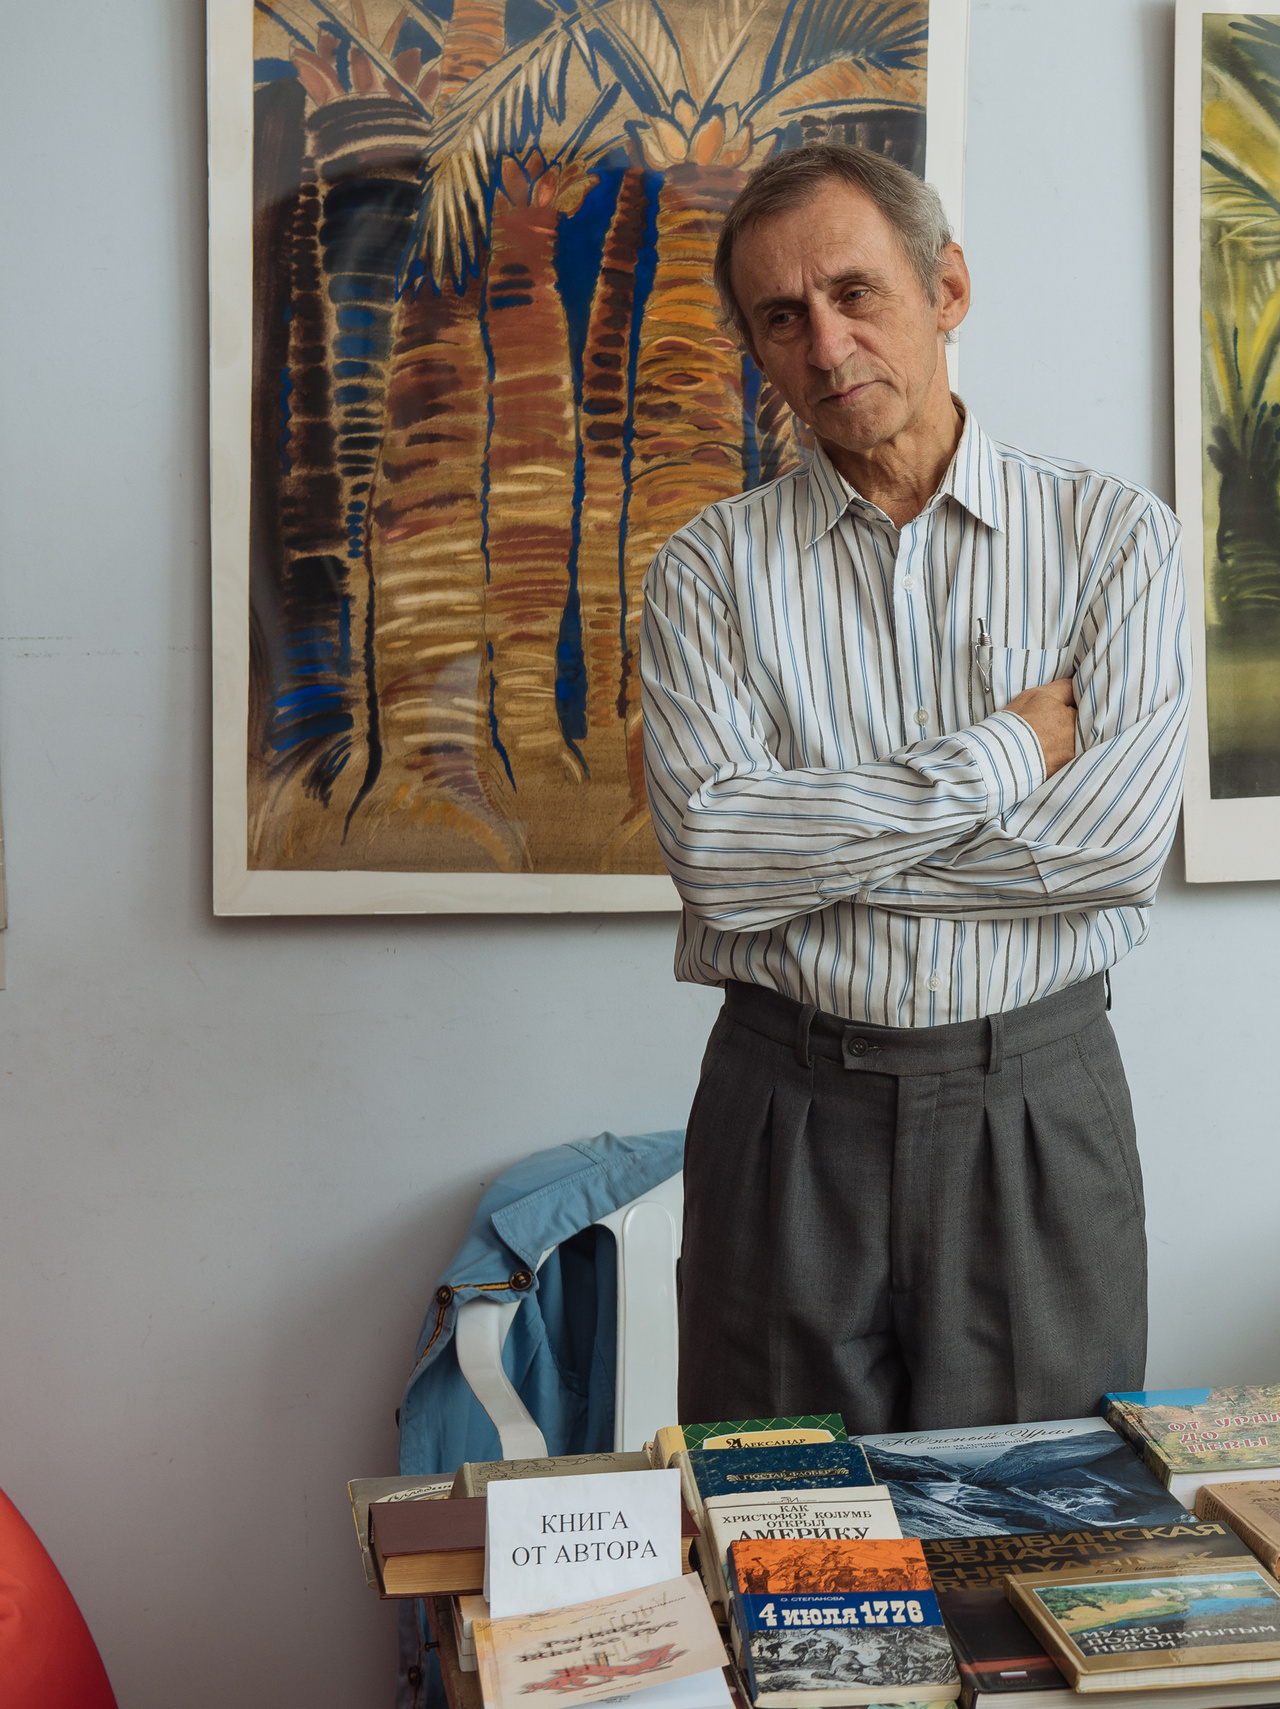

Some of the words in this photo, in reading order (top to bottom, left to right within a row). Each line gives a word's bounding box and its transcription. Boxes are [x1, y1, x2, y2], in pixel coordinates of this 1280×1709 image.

[1168, 1421, 1200, 1431] ОТ
[1180, 1431, 1219, 1444] ДО
[1187, 1437, 1268, 1453] НЕВЫ
[541, 1511, 629, 1534] КНИГА
[722, 1512, 807, 1523] ХРИСТОФОР
[815, 1511, 872, 1519] КОЛУМБ
[766, 1519, 826, 1528] ОТКРЫЛ
[739, 1527, 870, 1540] АМЕРИКУ
[511, 1545, 547, 1566] ОТ
[554, 1539, 658, 1564] АВТОРА
[926, 1542, 1123, 1565] ОБЛАСТЬ
[758, 1602, 778, 1627] 4
[781, 1607, 859, 1626] июля
[860, 1600, 924, 1624] 1776
[1083, 1626, 1160, 1639] МУЗЕЙ
[1088, 1634, 1141, 1647] ПОД
[1145, 1625, 1277, 1642] ОТКРЫТЫМ
[1092, 1640, 1178, 1653] НЕБОМ
